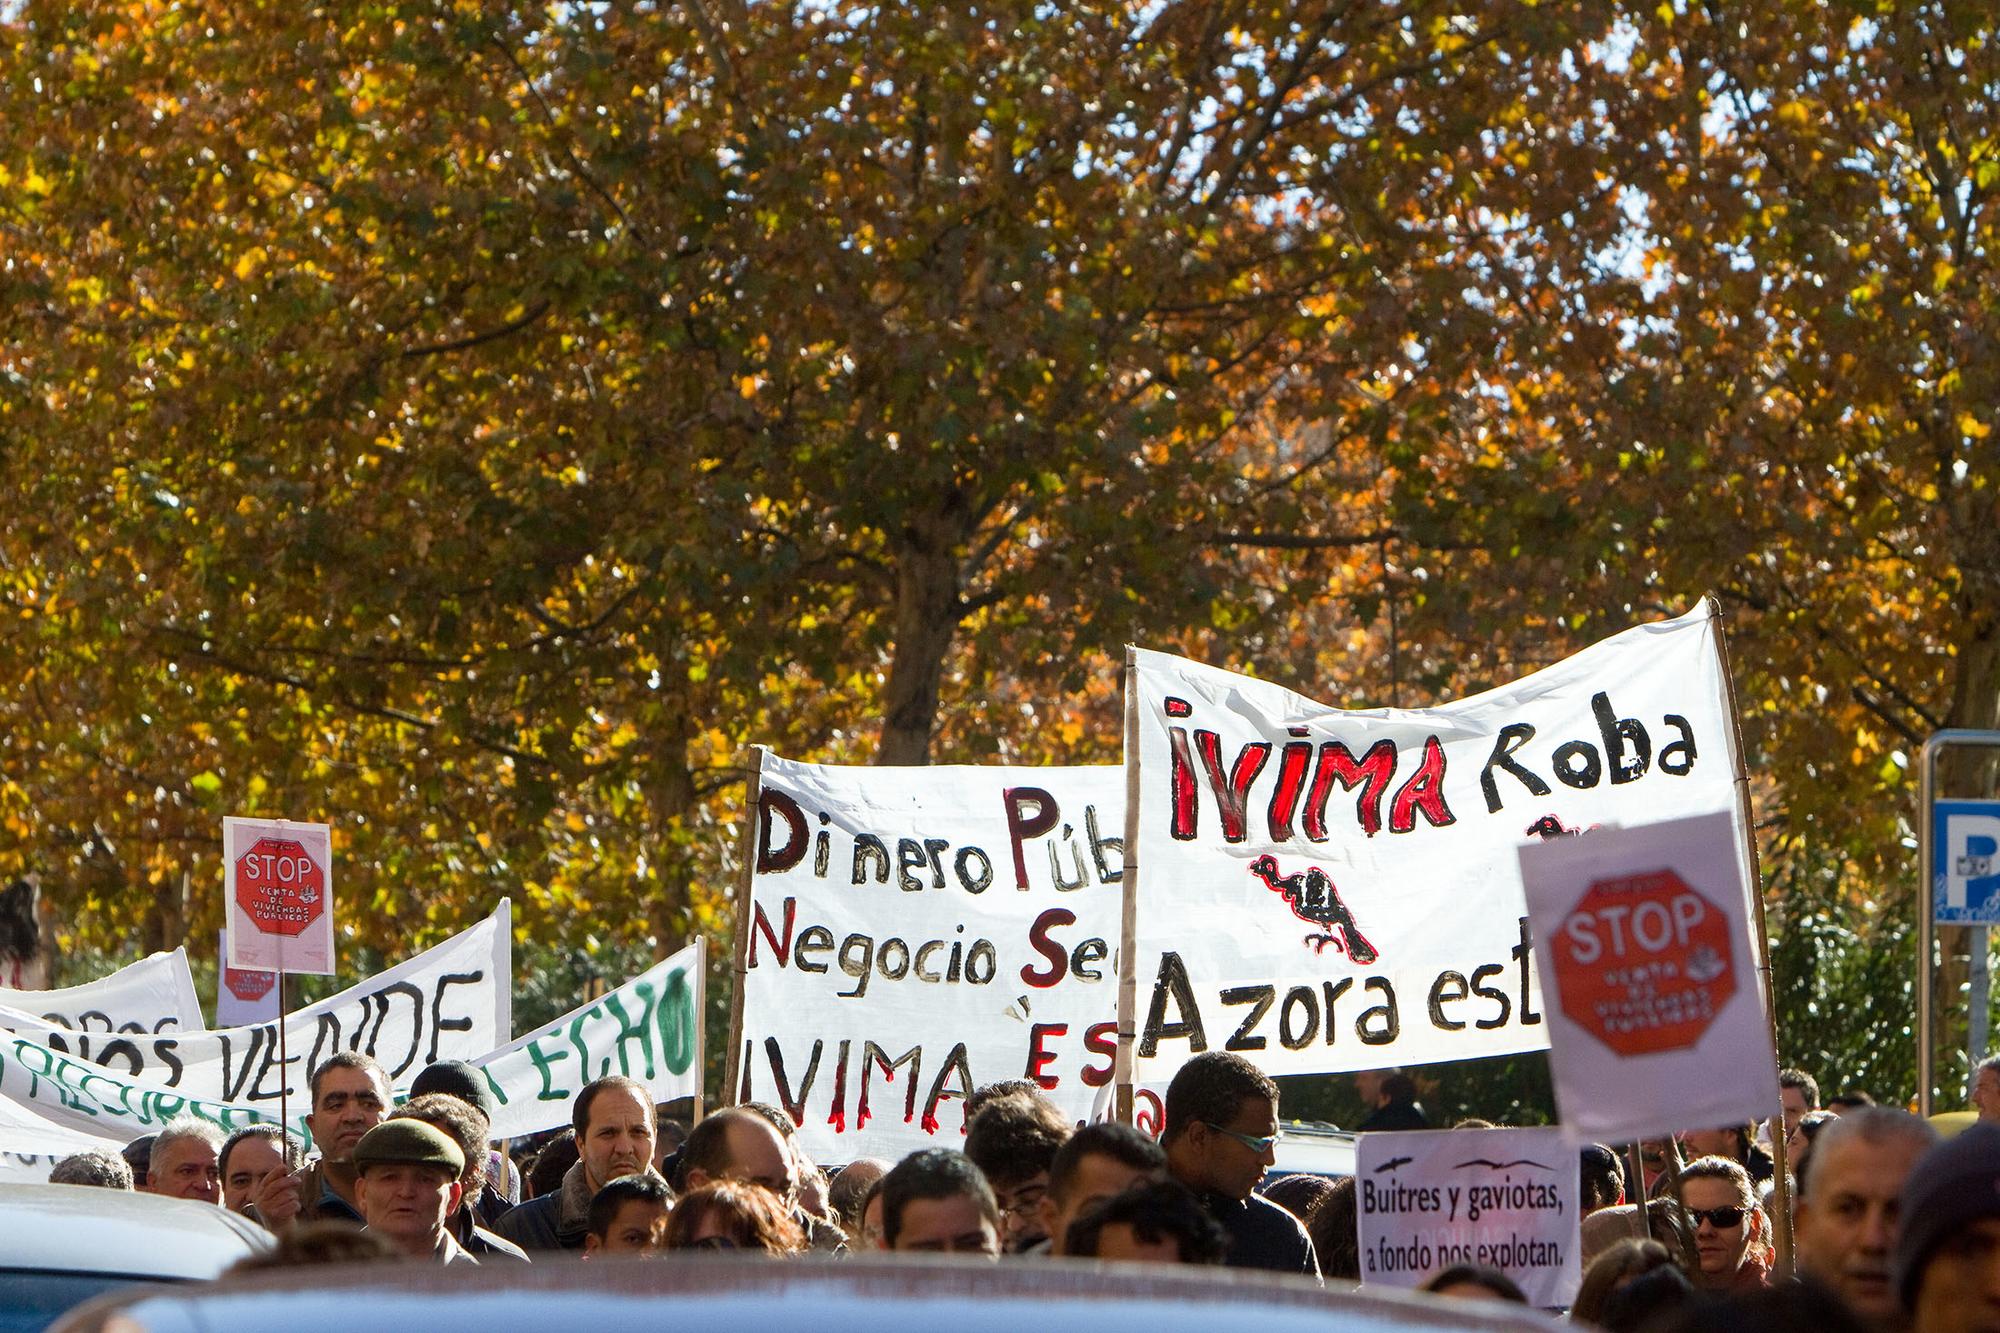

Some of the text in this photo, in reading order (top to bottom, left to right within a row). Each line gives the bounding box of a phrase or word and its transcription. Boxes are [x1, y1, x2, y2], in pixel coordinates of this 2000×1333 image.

[1480, 691, 1698, 813] Roba
[245, 853, 313, 883] STOP
[757, 786, 993, 894] Dinero
[1947, 814, 2000, 908] P
[252, 900, 309, 914] VIVIENDAS
[260, 886, 295, 897] VENTA
[270, 897, 283, 905] DE
[748, 896, 1119, 998] Negocio Se
[1566, 894, 1705, 964] STOP
[1137, 951, 1400, 1058] Azora
[1363, 1175, 1563, 1222] Buitres y gaviotas,
[1367, 1233, 1564, 1272] a fondo nos explotan.
